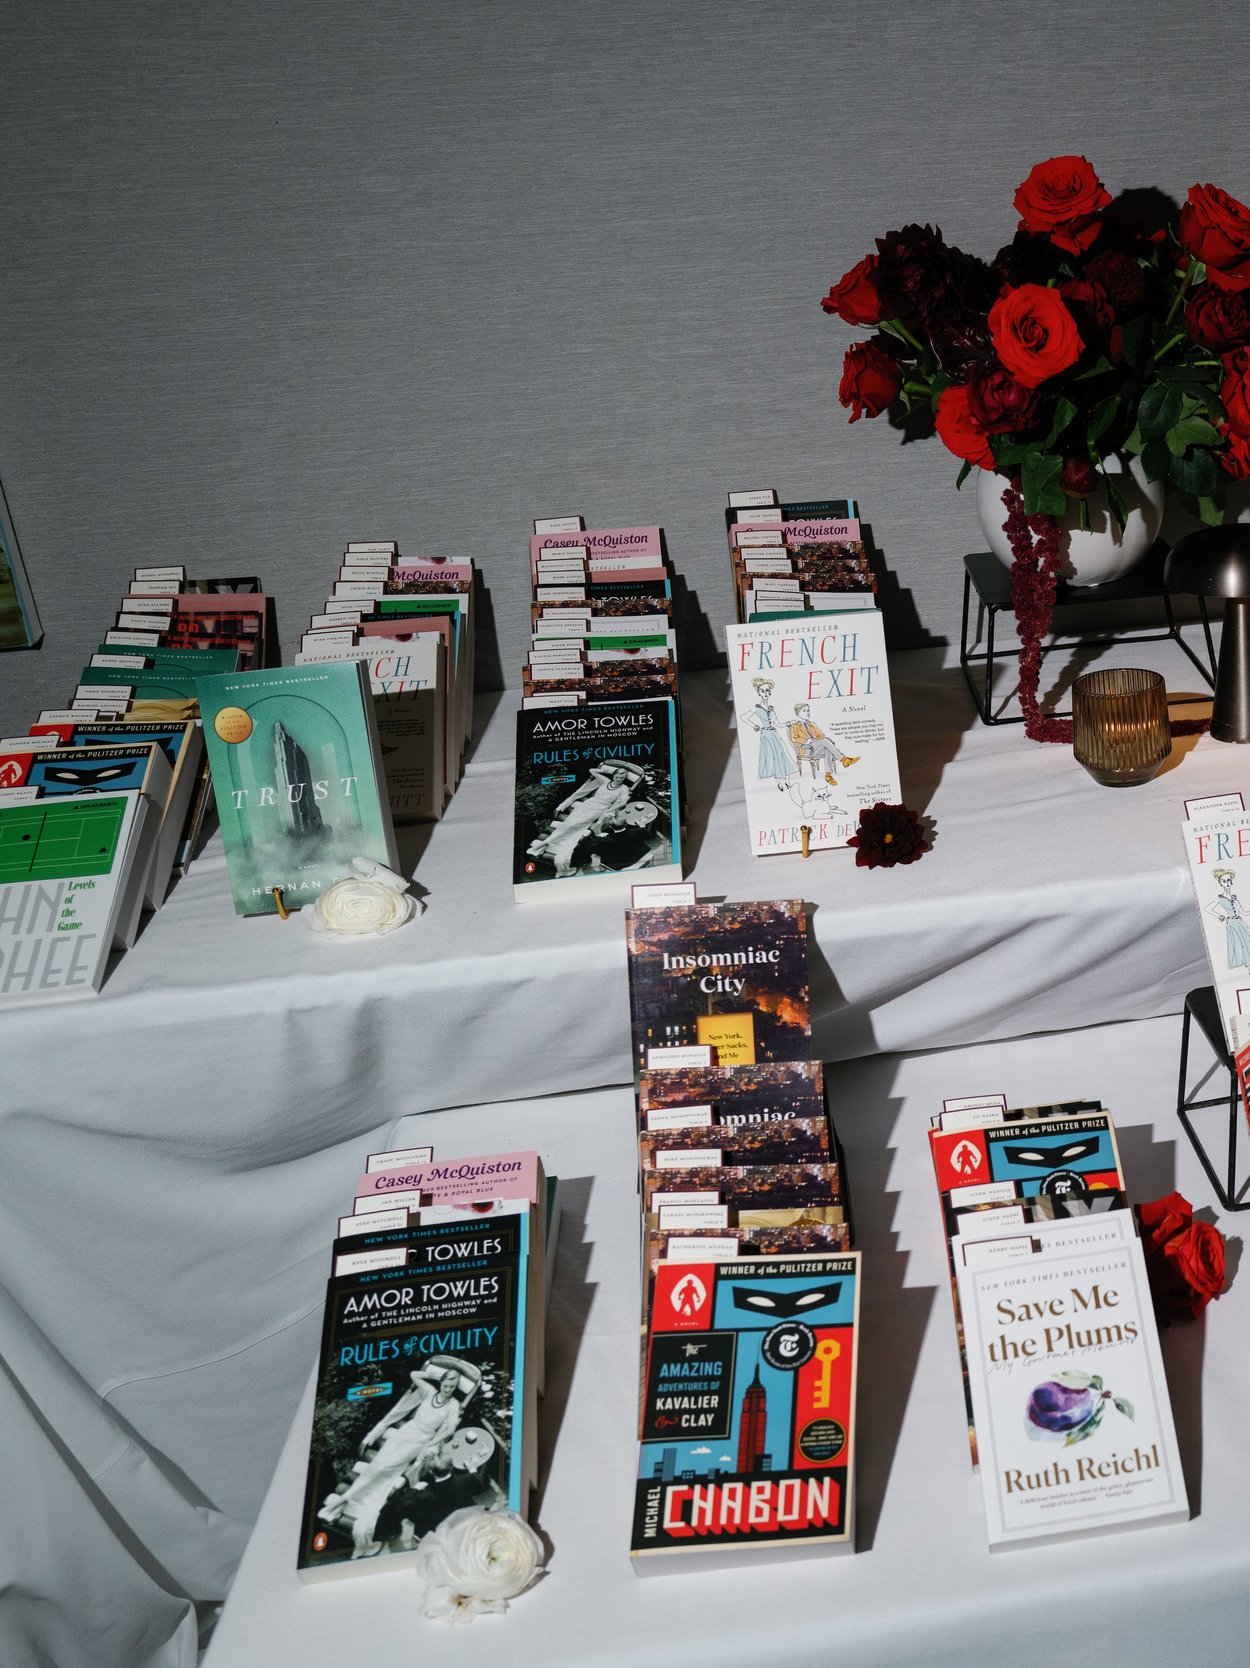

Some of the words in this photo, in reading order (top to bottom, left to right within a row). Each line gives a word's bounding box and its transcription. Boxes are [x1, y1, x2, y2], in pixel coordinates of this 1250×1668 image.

[737, 633, 859, 673] FRENCH
[285, 674, 329, 684] BESTSELLER
[807, 665, 879, 700] EXIT
[532, 718, 588, 733] AMOR
[592, 713, 654, 728] TOWLES
[532, 747, 579, 765] RULES
[582, 746, 593, 762] of
[594, 742, 656, 760] CIVILITY
[232, 777, 358, 810] TRUST
[67, 879, 96, 892] Levels
[64, 894, 75, 905] of
[61, 907, 76, 918] the
[57, 920, 82, 932] Game
[662, 946, 780, 971] Insomniac
[699, 974, 746, 996] City
[375, 1170, 424, 1193] Casey
[427, 1158, 523, 1184] McQuiston
[719, 1264, 756, 1275] WINNER
[756, 1265, 765, 1275] of
[765, 1265, 778, 1273] the
[779, 1262, 823, 1273] PULITZER
[825, 1260, 853, 1271] PRIZE
[343, 1287, 414, 1315] AMOR
[420, 1275, 499, 1302] TOWLES
[995, 1297, 1065, 1326] Save
[1070, 1284, 1120, 1316] Me
[342, 1315, 368, 1324] Author
[369, 1312, 379, 1320] of
[381, 1309, 398, 1317] THE
[400, 1304, 439, 1315] LINCOLN
[441, 1298, 482, 1309] HIGHWAY
[483, 1296, 498, 1304] and
[369, 1313, 423, 1327] GENTLEMAN
[425, 1311, 435, 1319] IN
[436, 1306, 478, 1318] MOSCOW
[339, 1338, 400, 1366] RULES
[403, 1337, 418, 1356] of
[419, 1326, 498, 1355] CIVILITY
[682, 1344, 708, 1357] the
[987, 1334, 1039, 1364] the
[1044, 1318, 1139, 1356] Plums
[659, 1360, 723, 1378] AMAZING
[656, 1381, 708, 1392] ADVENTURES
[709, 1380, 720, 1390] OF
[655, 1395, 720, 1412] KAVALIER
[680, 1412, 715, 1428] CLAY
[1003, 1463, 1071, 1495] Ruth
[1076, 1444, 1161, 1482] Reichl
[643, 1486, 661, 1539] MICHAEL
[663, 1477, 833, 1532] CHABON
